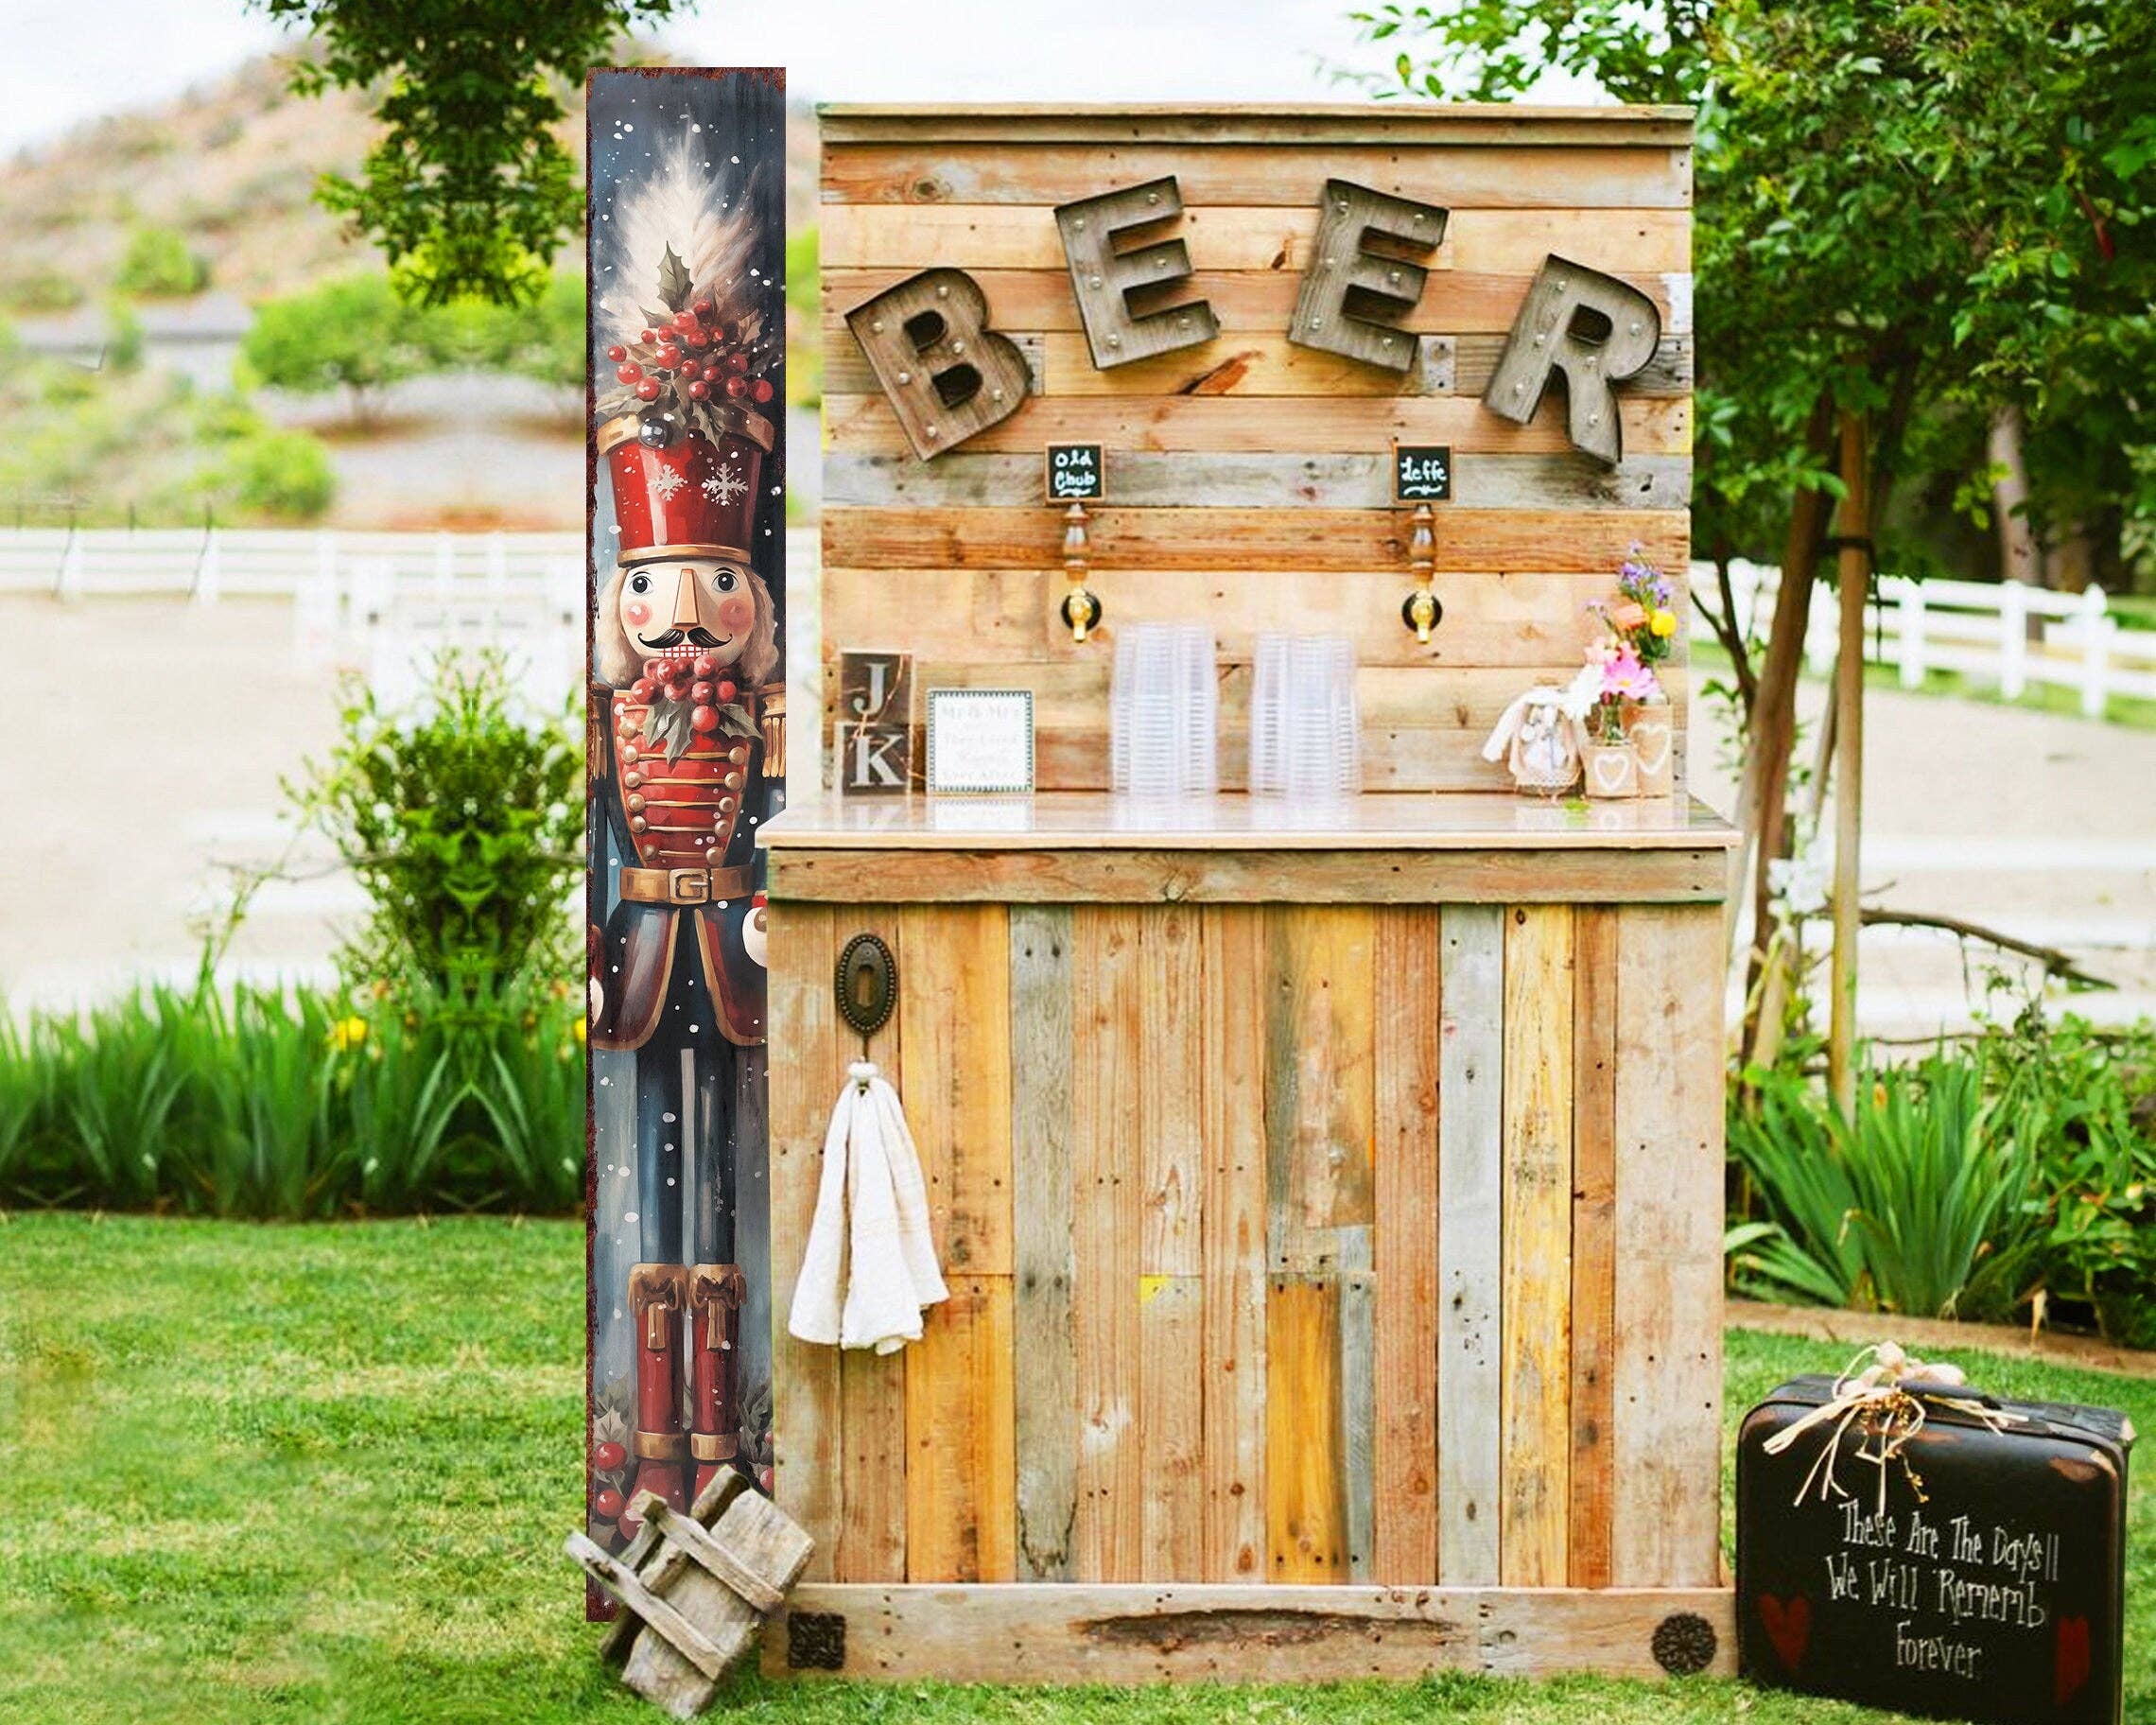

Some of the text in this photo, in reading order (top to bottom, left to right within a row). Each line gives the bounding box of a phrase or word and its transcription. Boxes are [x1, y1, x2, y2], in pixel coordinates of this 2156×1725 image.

[844, 174, 1661, 465] BEER
[1054, 449, 1093, 467] Old
[1400, 456, 1447, 481] Leffe
[853, 663, 891, 714] J
[850, 734, 908, 787] K
[1838, 1498, 1896, 1547] These
[1905, 1511, 1939, 1560] Are
[1950, 1514, 1983, 1565] The
[1825, 1551, 1860, 1600] We
[1869, 1558, 1919, 1612] Will
[1896, 1619, 1982, 1679] Forever
